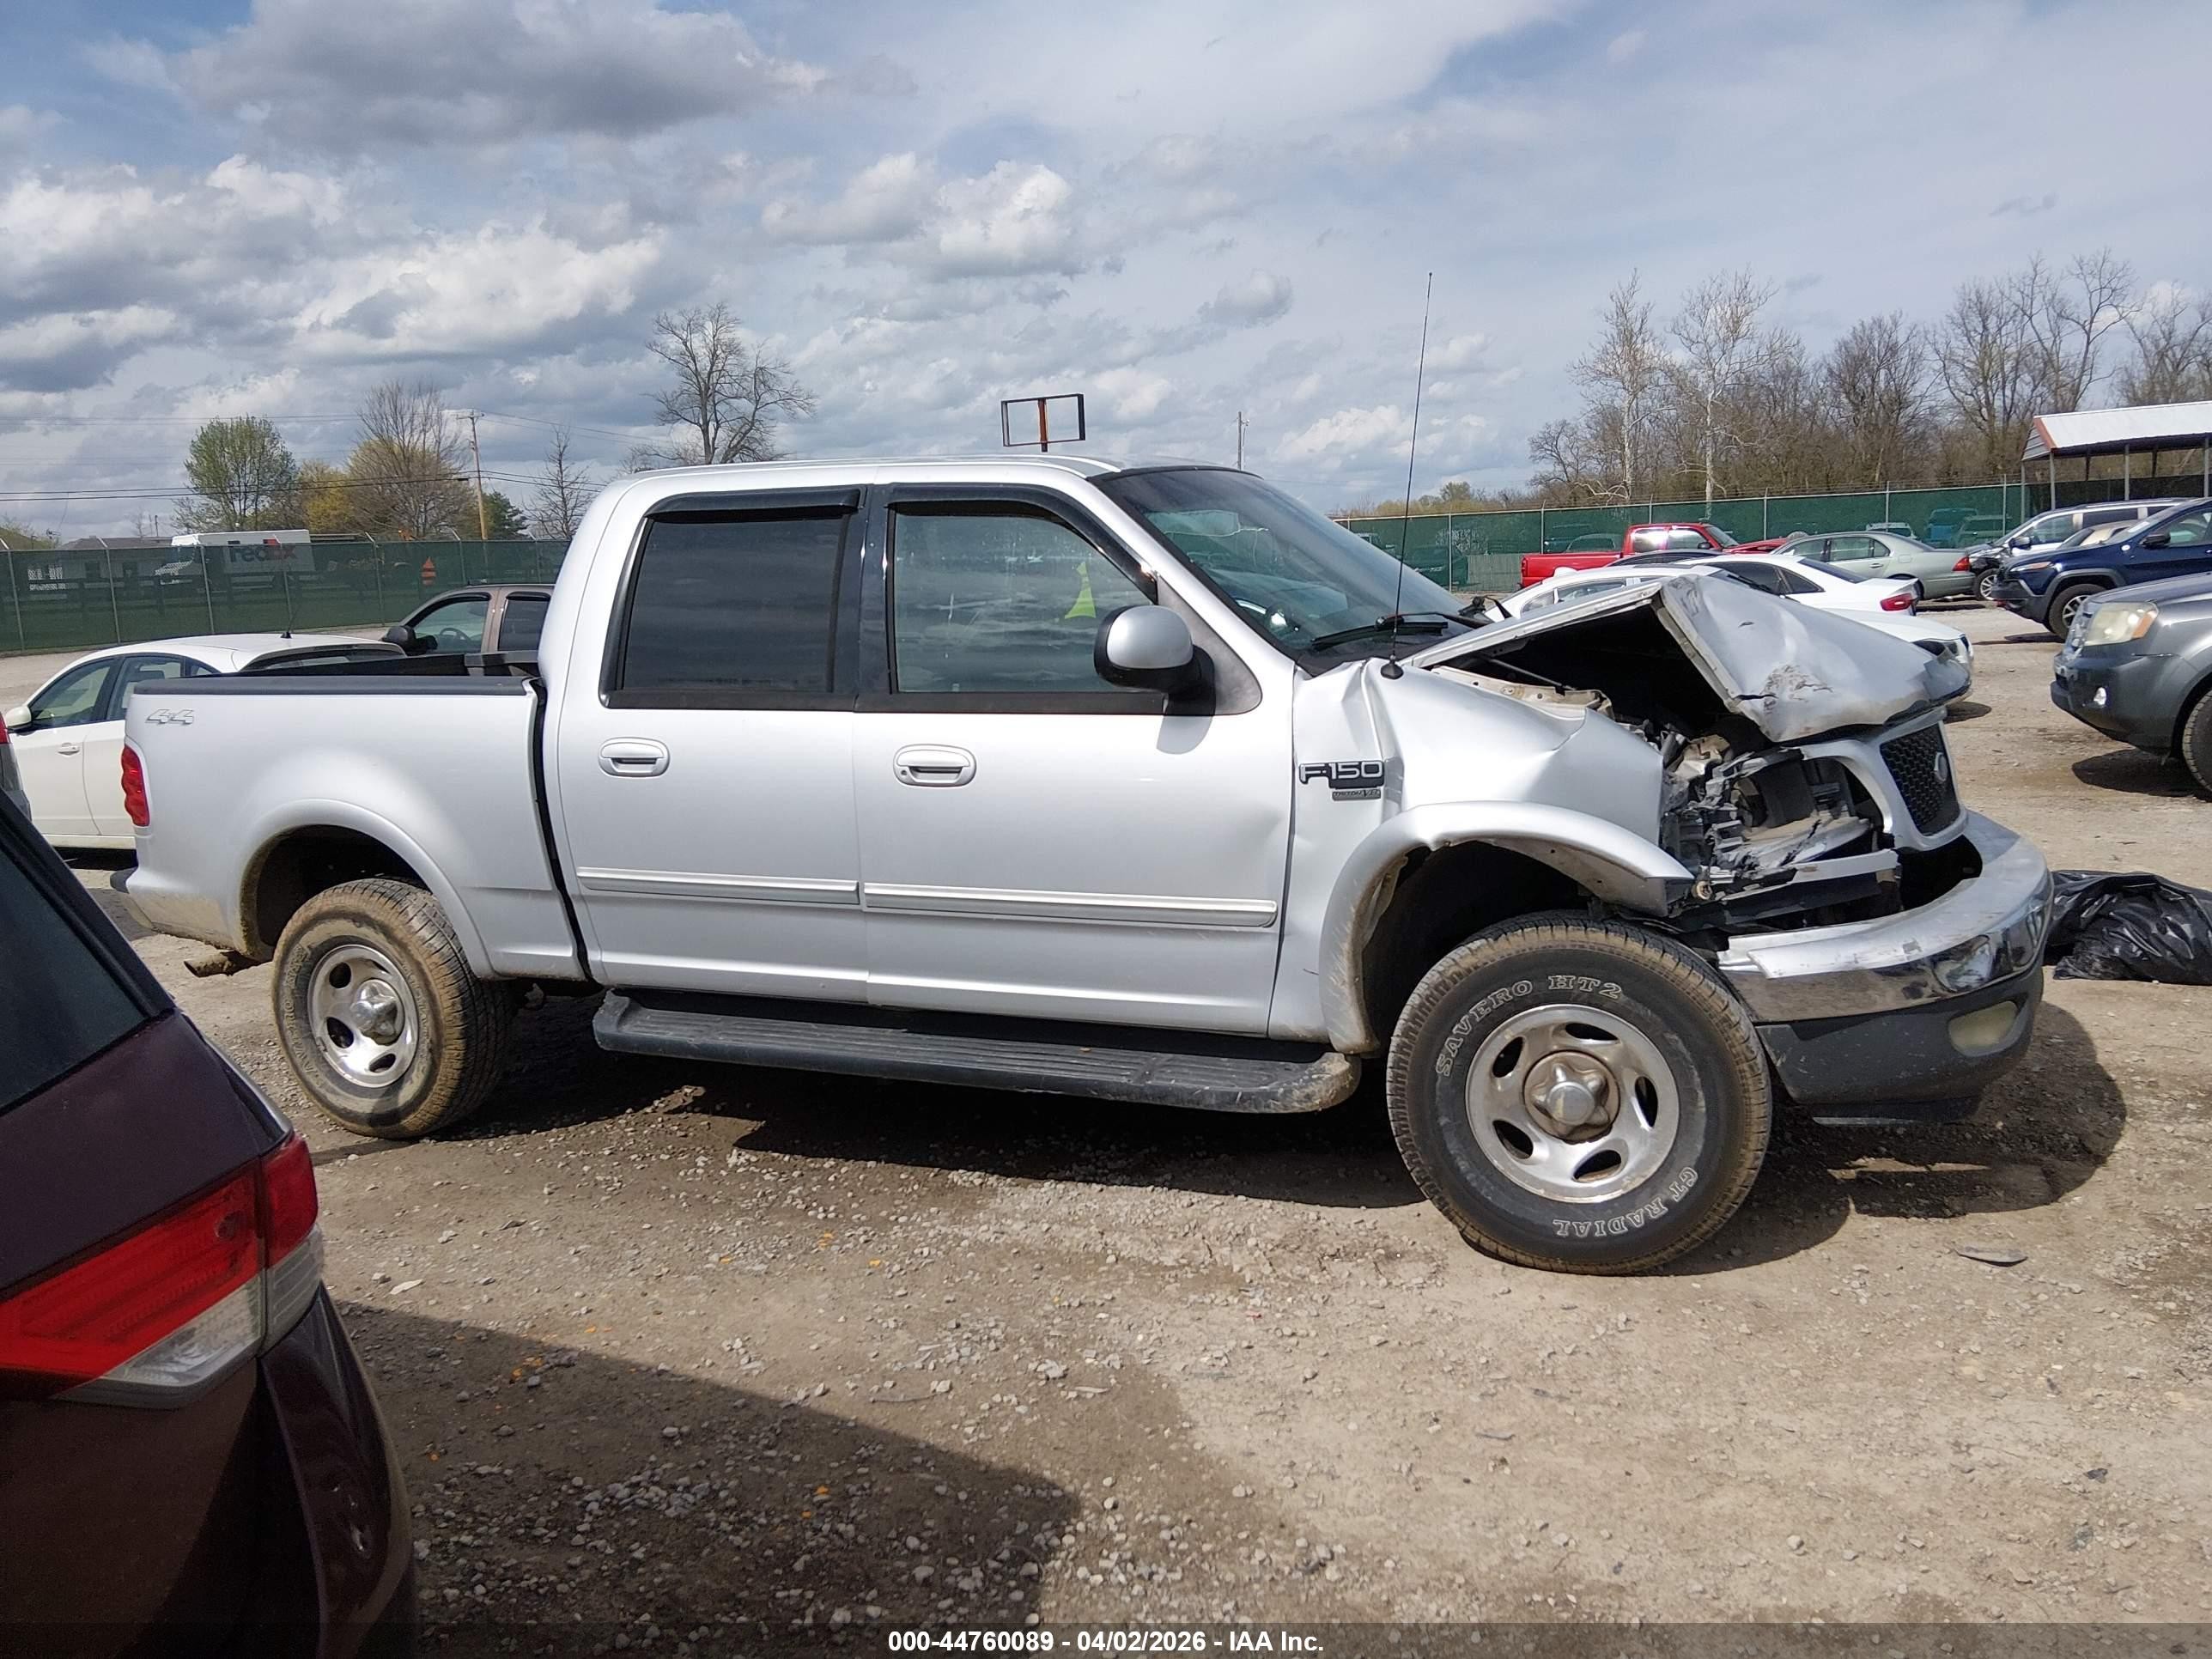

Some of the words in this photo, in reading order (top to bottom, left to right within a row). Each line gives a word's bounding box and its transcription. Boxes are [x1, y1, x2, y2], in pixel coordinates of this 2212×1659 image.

[1299, 761, 1383, 783] F-150
[1436, 979, 1534, 1078] SAVERO
[1547, 974, 1623, 1000] HT2
[1668, 1165, 1698, 1202] GT
[1553, 1196, 1669, 1237] RADIAL
